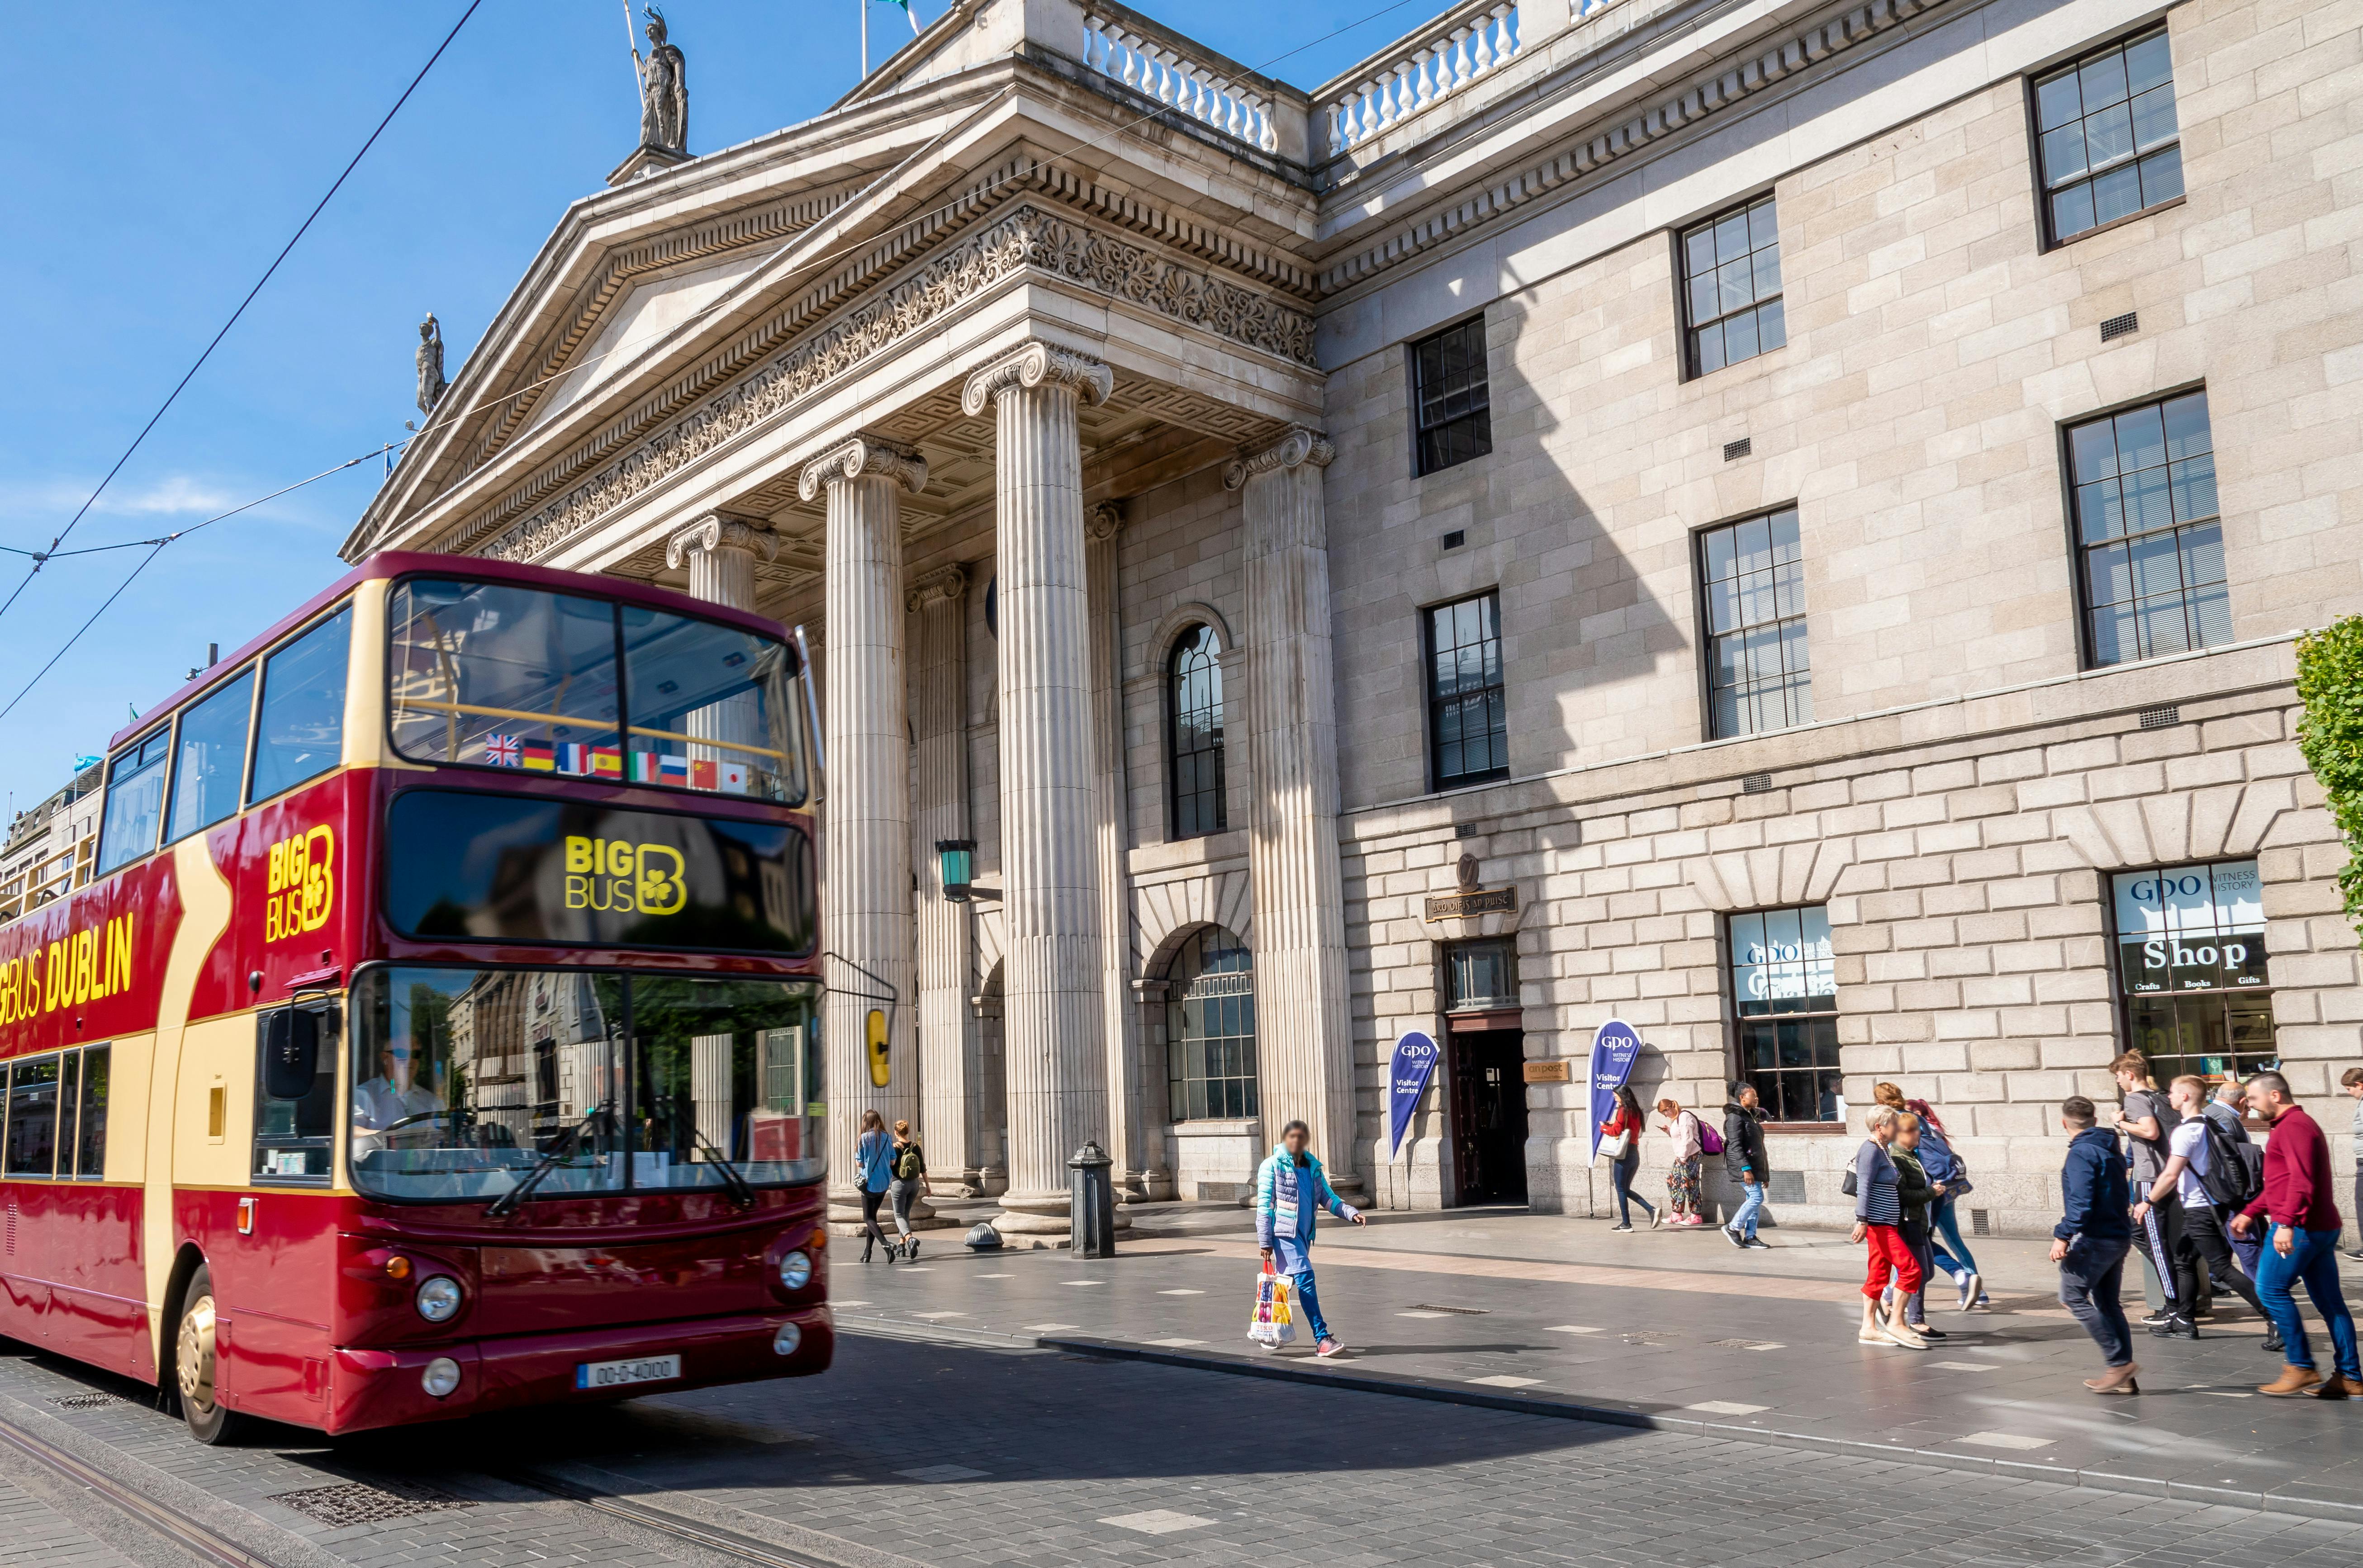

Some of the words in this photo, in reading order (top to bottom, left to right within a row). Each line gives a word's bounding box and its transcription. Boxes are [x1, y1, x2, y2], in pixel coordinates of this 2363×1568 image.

[268, 834, 304, 895] BIG
[566, 835, 634, 876] BIG
[2207, 870, 2255, 882] WITNESS
[2210, 880, 2254, 893] HISTORY
[566, 876, 634, 912] BUS
[2131, 876, 2201, 905] GPO
[266, 891, 302, 943] BUS
[1804, 942, 1831, 951] WITNES
[1804, 950, 1831, 959] HISTOR
[2144, 939, 2246, 970] Shop
[46, 912, 133, 1013] DUBLIN
[2135, 982, 2160, 990] Crafts
[2185, 980, 2211, 988] Books
[2238, 976, 2260, 985] Gifts
[1401, 1046, 1430, 1058] GPO
[1602, 1036, 1632, 1051] GPO
